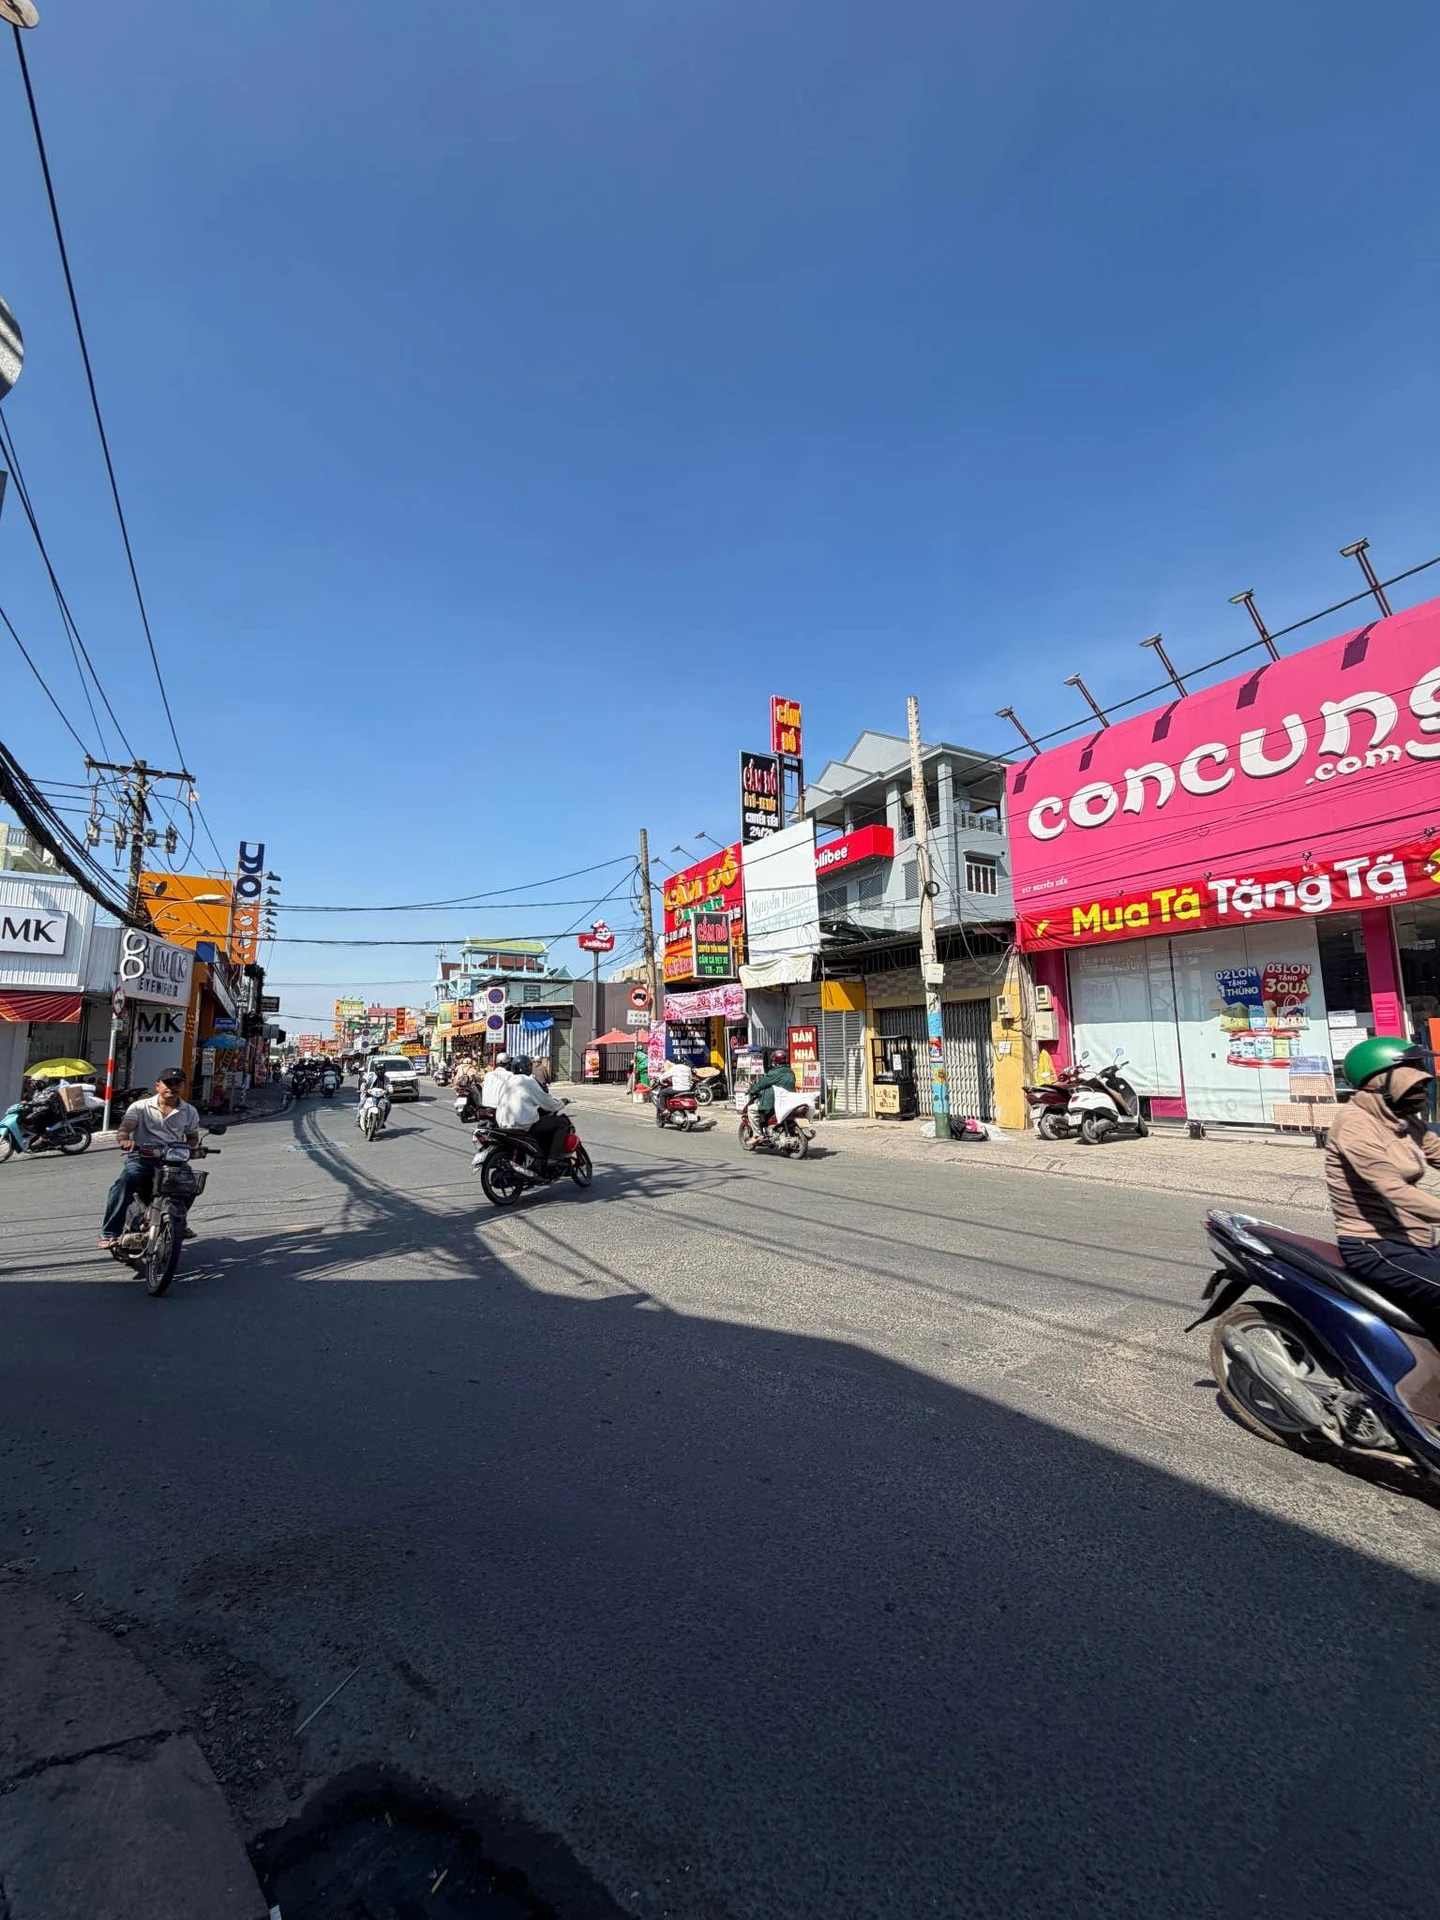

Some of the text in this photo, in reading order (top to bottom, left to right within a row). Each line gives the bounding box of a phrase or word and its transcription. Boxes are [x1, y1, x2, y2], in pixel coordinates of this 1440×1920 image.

[1306, 744, 1402, 786] .com
[814, 844, 848, 870] ollibee
[1073, 853, 1408, 937] Mua Tã Tặng Tã
[2, 916, 57, 943] MK
[1276, 979, 1310, 995] QUÀ
[138, 1012, 183, 1034] MK
[792, 1031, 813, 1043] BÁN
[794, 1047, 816, 1061] NHÀ
